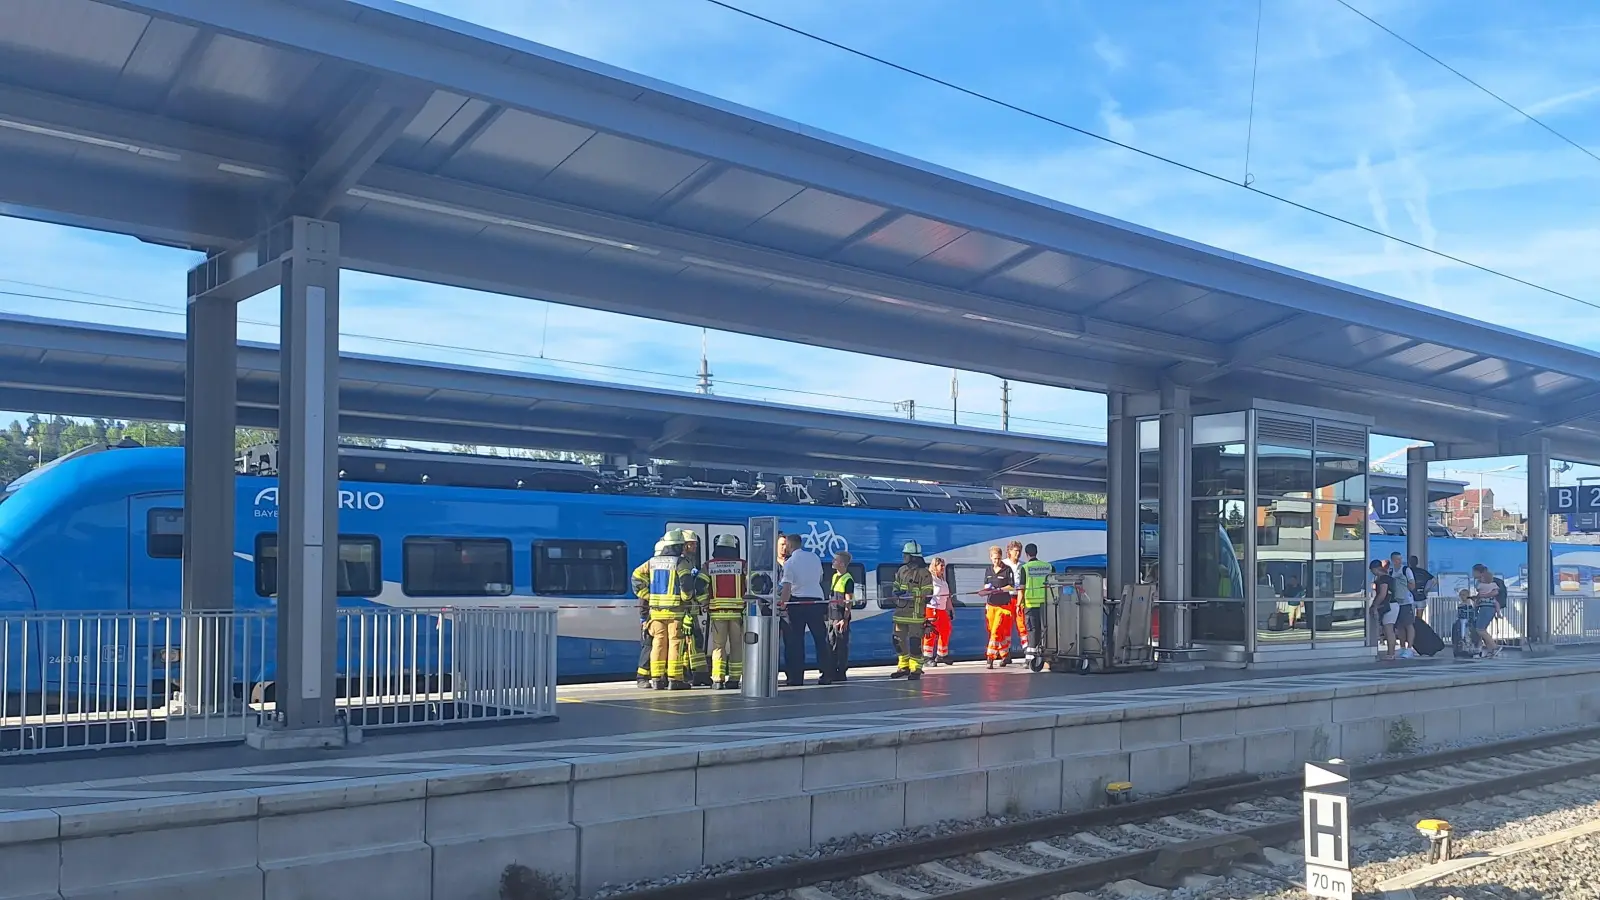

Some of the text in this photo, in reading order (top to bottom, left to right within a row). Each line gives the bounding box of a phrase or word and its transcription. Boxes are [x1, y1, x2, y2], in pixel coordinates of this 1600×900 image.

[254, 487, 385, 511] ARIO
[1559, 487, 1600, 508] B 2
[1309, 797, 1343, 862] H
[1312, 872, 1346, 893] 70 m
